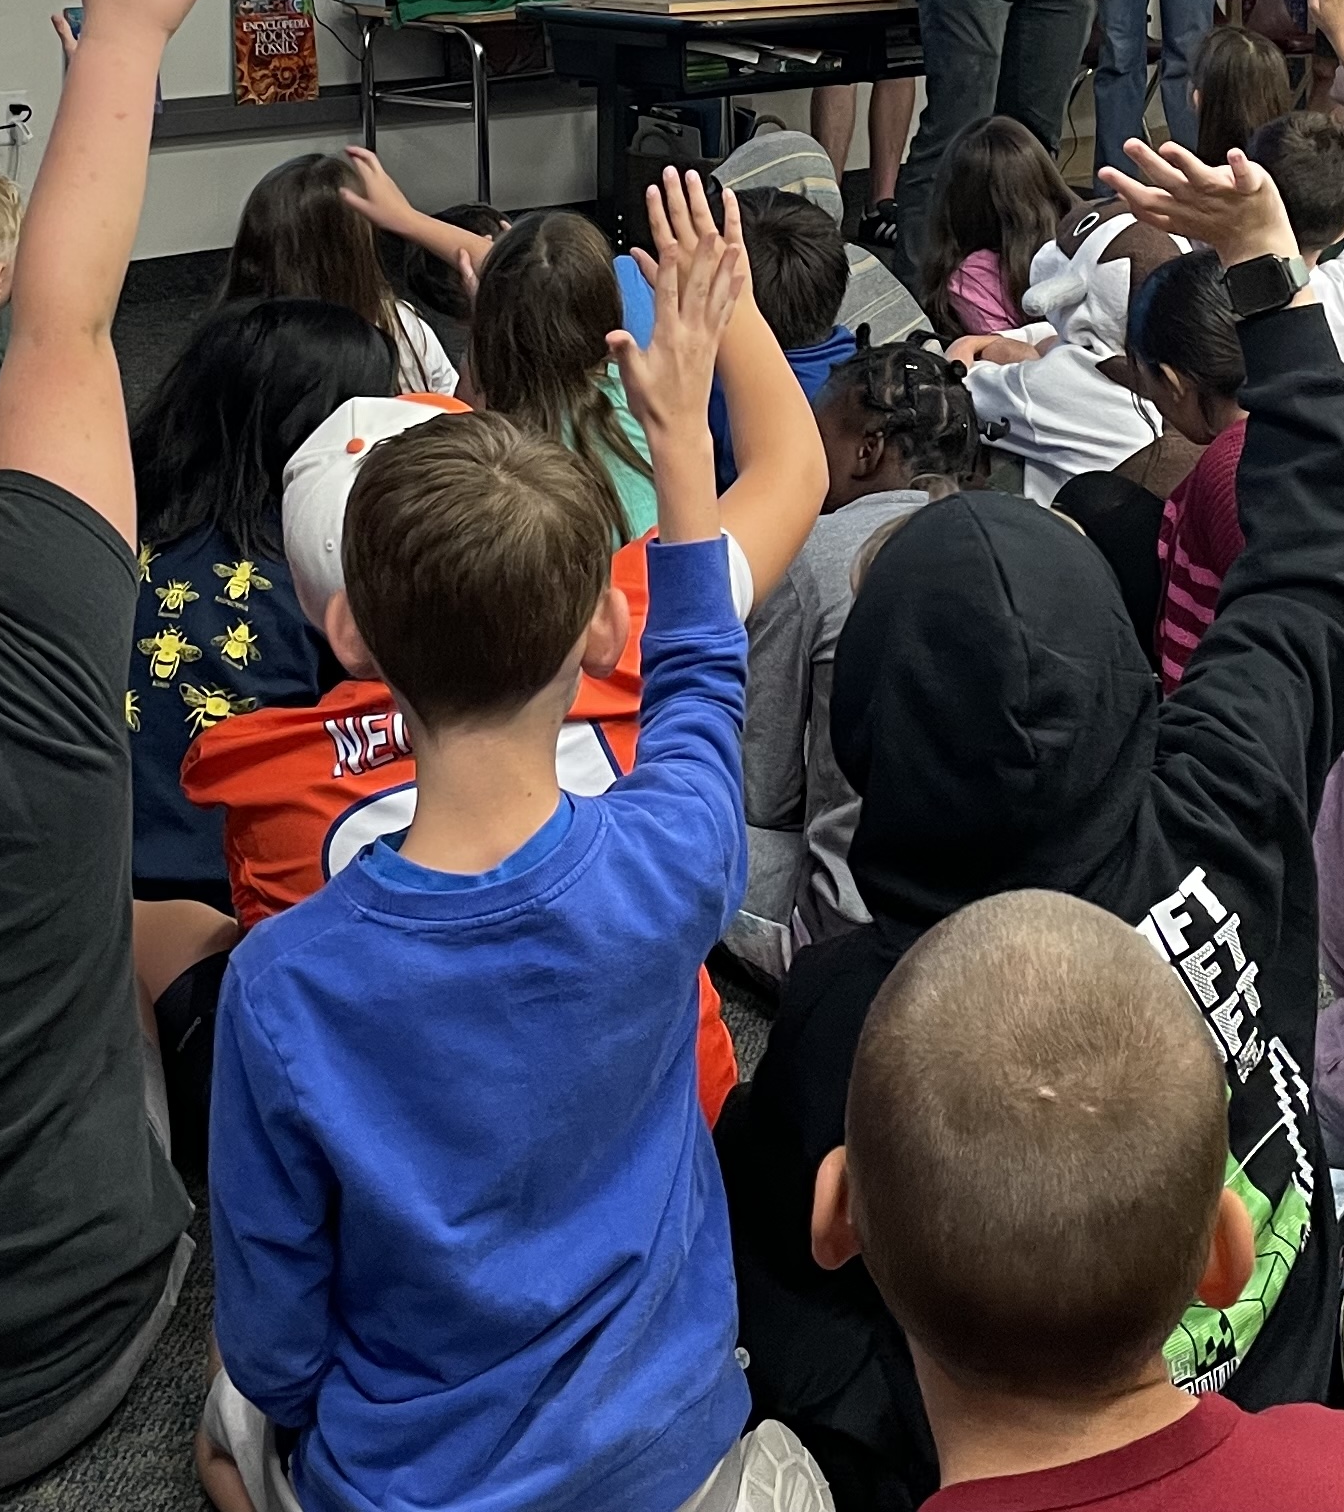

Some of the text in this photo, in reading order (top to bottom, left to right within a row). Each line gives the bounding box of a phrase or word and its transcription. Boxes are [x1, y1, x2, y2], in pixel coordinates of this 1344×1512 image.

[242, 18, 311, 32] ENCYCLOPEDIA
[256, 29, 297, 44] ROCKS
[255, 41, 299, 56] FOSSILS
